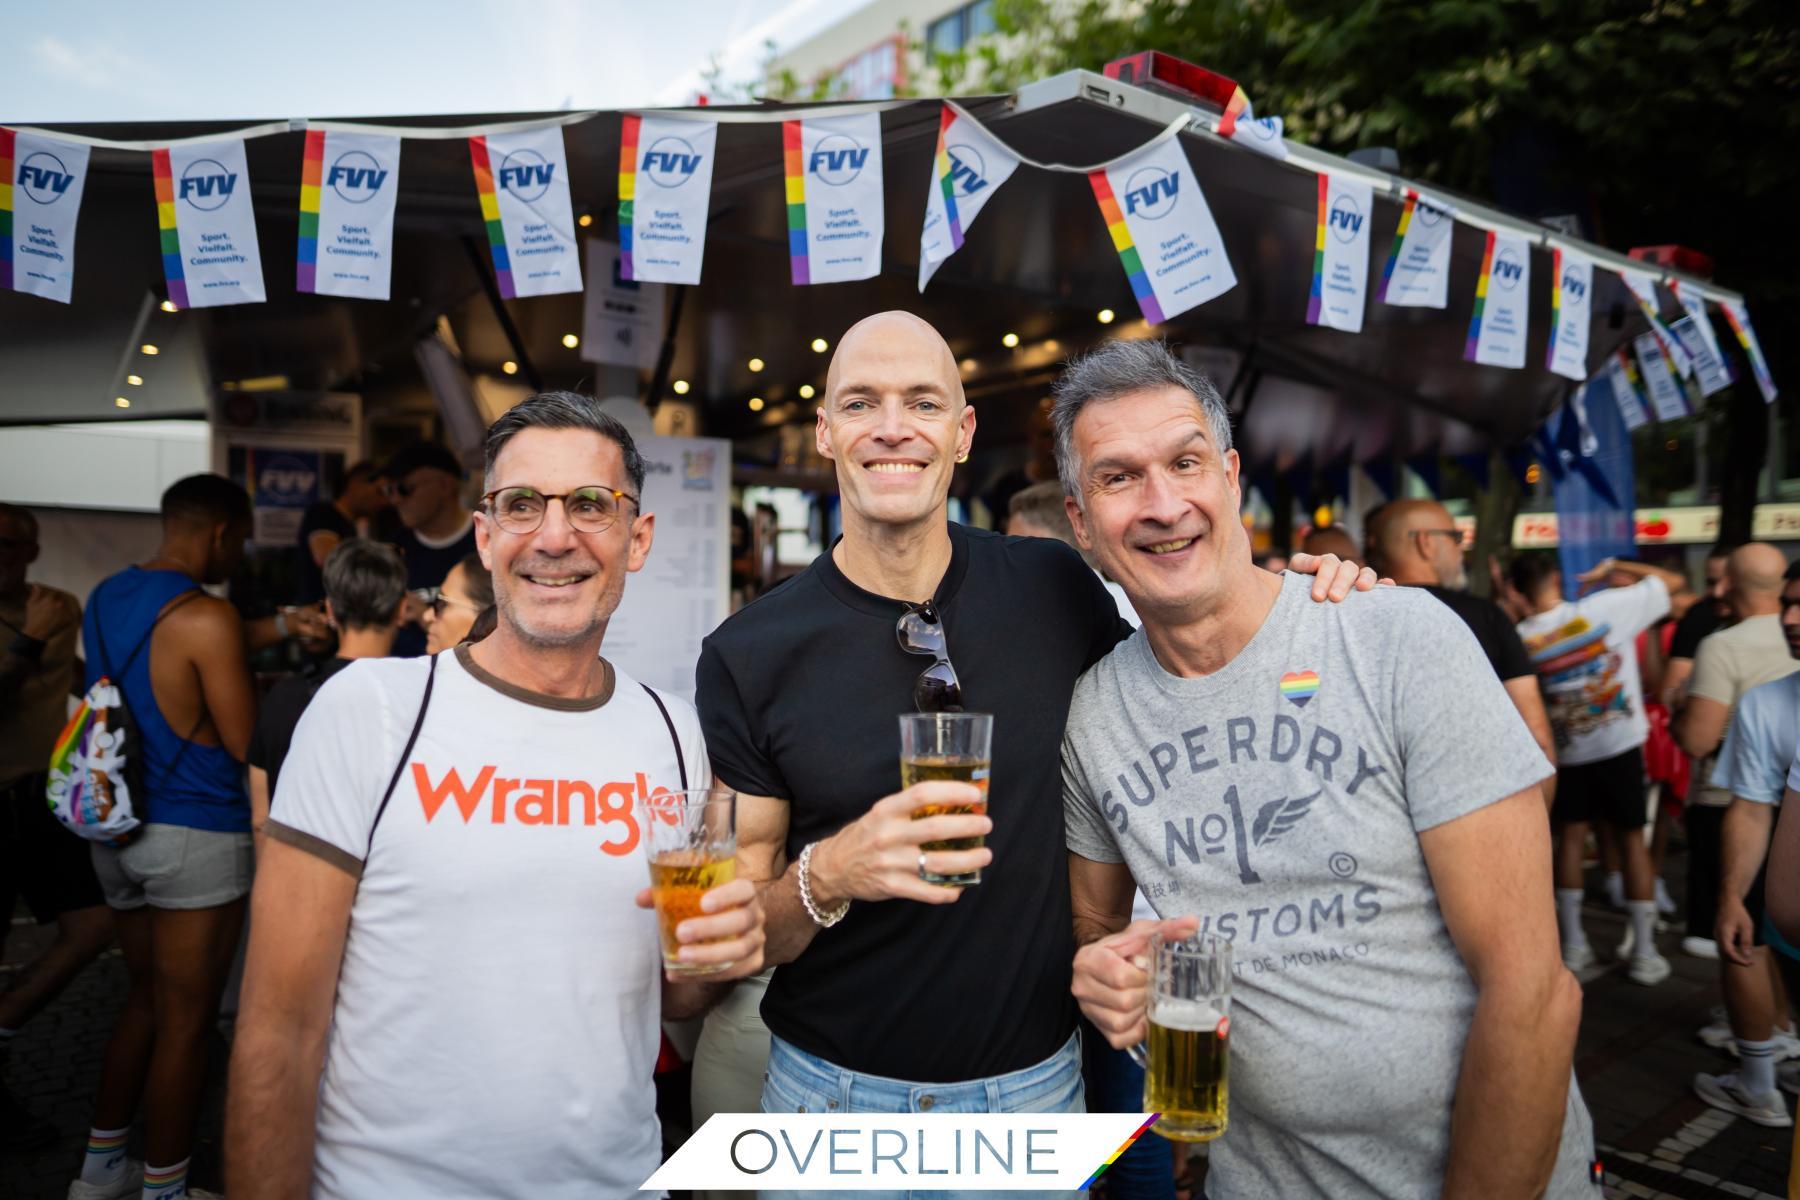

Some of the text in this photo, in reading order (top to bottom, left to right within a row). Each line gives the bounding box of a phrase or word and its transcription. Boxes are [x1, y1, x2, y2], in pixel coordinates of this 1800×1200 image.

[641, 152, 703, 174] FVV
[809, 148, 869, 173] FVV
[17, 165, 75, 194] FVV
[179, 174, 237, 199] FVV
[327, 165, 388, 190] FVV
[500, 163, 555, 189] FVV
[1124, 171, 1180, 216] FVV
[1329, 208, 1363, 233] FVV
[190, 254, 248, 266] Community.
[1493, 260, 1523, 281] FVV
[1102, 714, 1387, 834] SUPERDRY
[1197, 885, 1383, 943] STOMS
[1253, 954, 1279, 973] DE
[1282, 942, 1369, 967] MONACO
